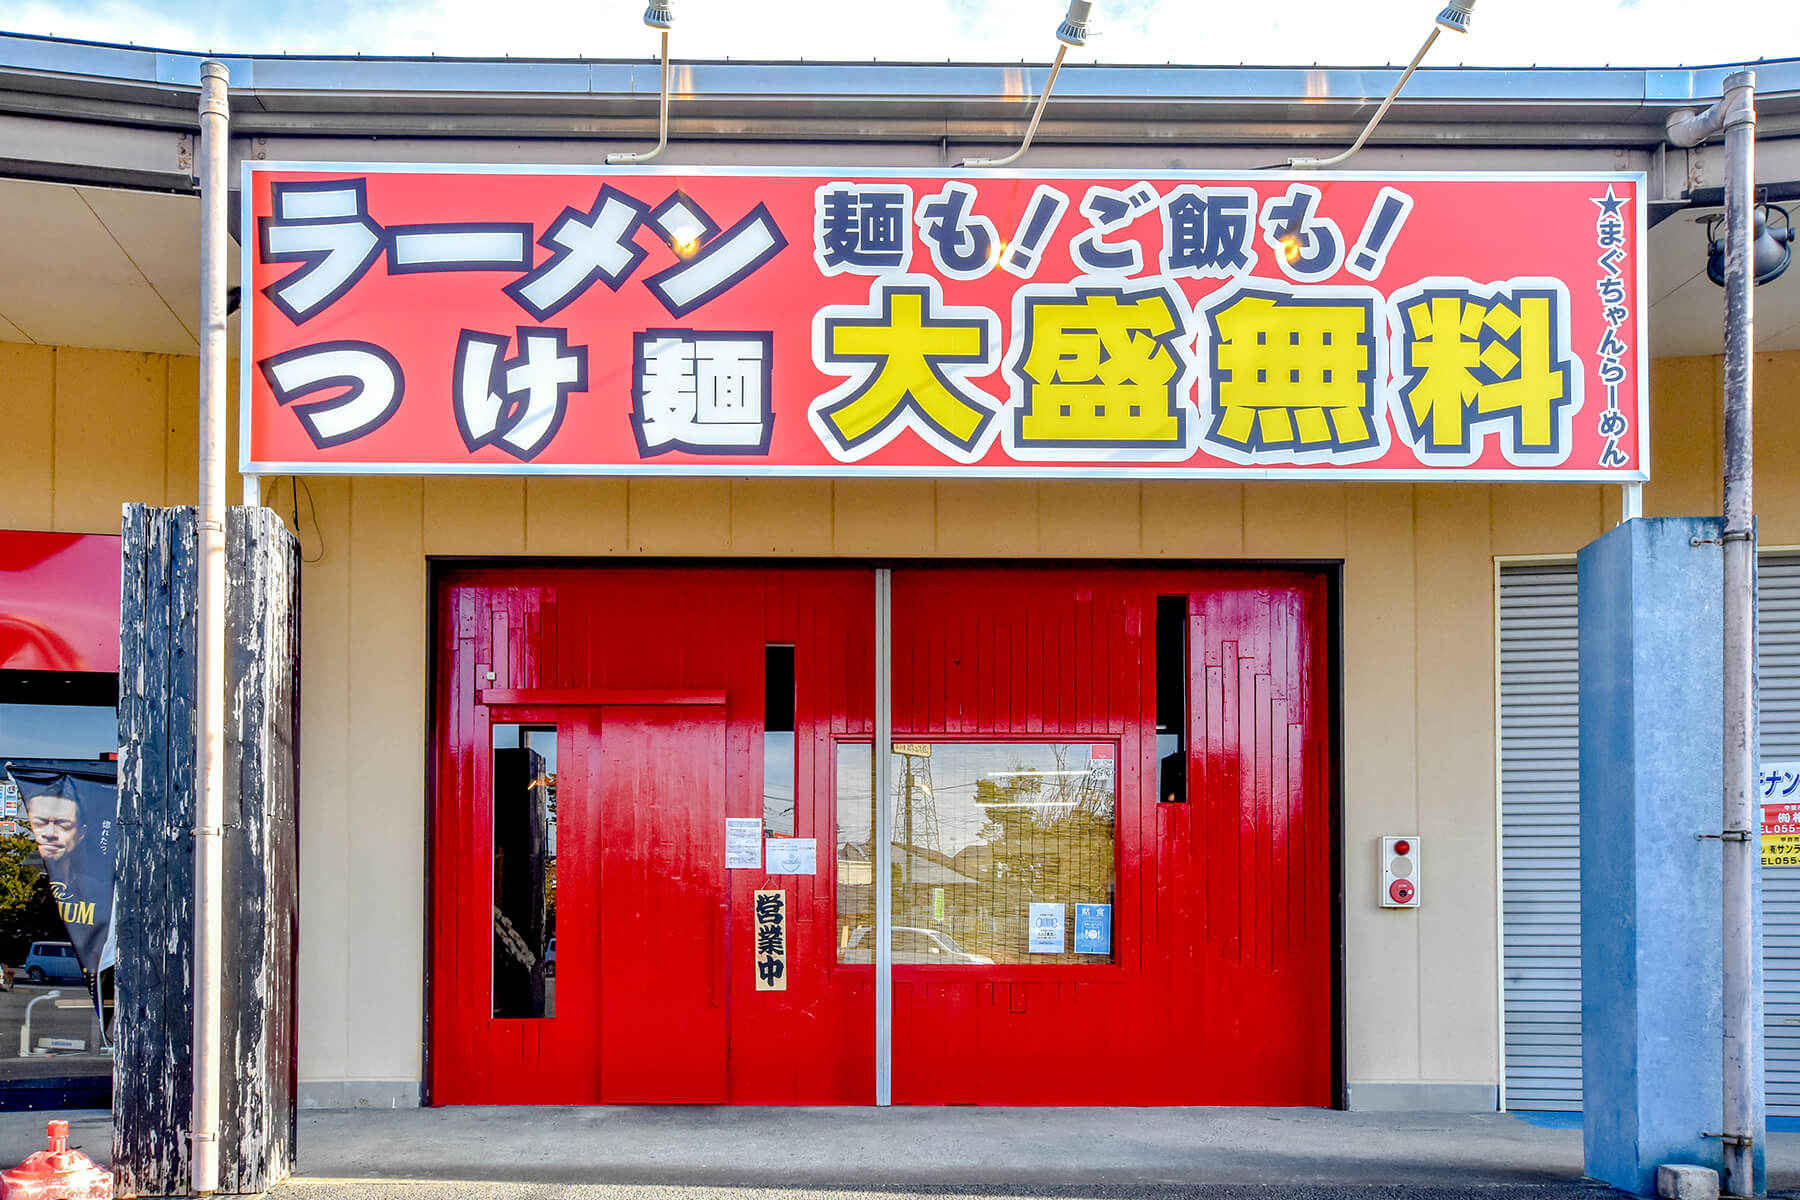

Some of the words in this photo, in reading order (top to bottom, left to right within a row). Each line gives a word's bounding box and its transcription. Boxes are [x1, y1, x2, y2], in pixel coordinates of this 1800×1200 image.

[259, 178, 788, 326] ラーメン
[258, 325, 776, 462] つけ麺
[815, 286, 1574, 457] 大盛無料
[756, 893, 784, 987] 営業中
